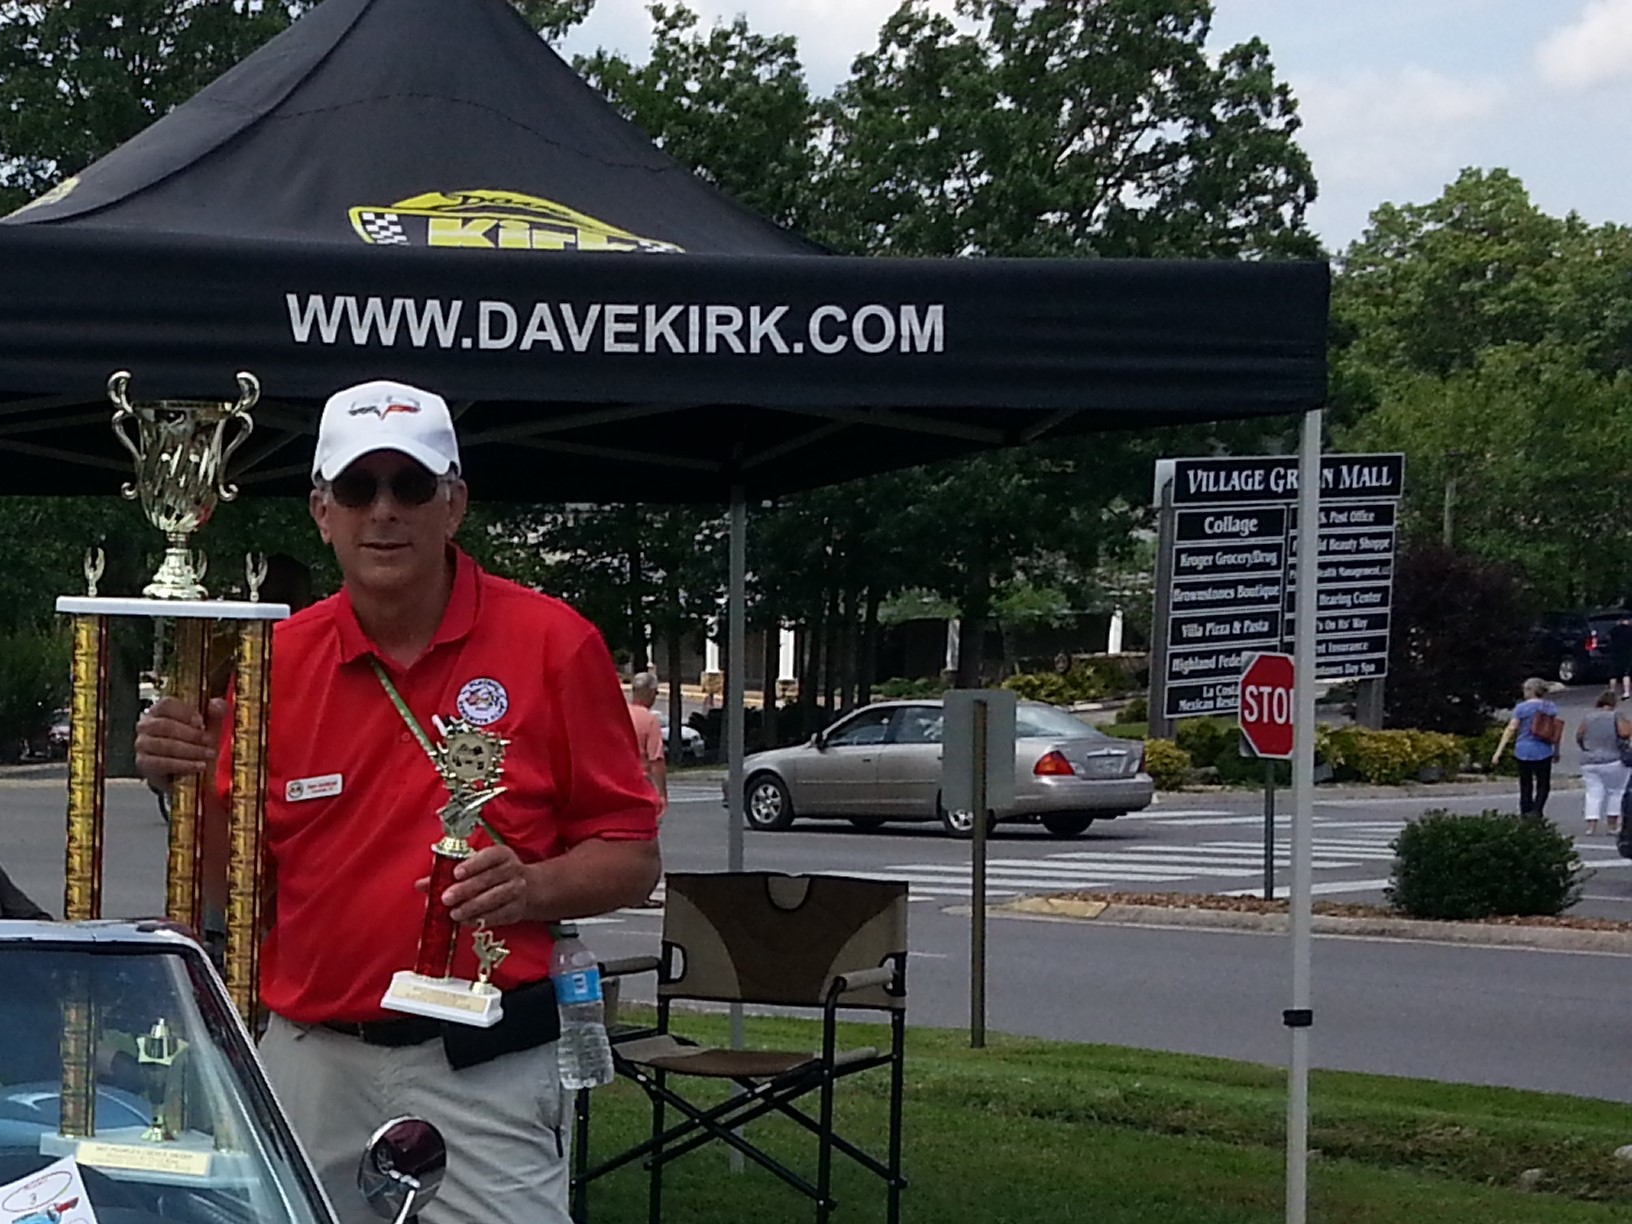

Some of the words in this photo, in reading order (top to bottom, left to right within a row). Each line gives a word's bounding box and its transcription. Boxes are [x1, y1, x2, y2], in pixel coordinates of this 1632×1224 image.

[285, 293, 945, 354] WWW.DAVEKIRK.COM
[1187, 468, 1265, 494] VILLAGE
[1269, 465, 1334, 494] GRN
[1339, 464, 1393, 489] MALL
[1204, 515, 1259, 537] Collage
[1243, 685, 1293, 725] STO
